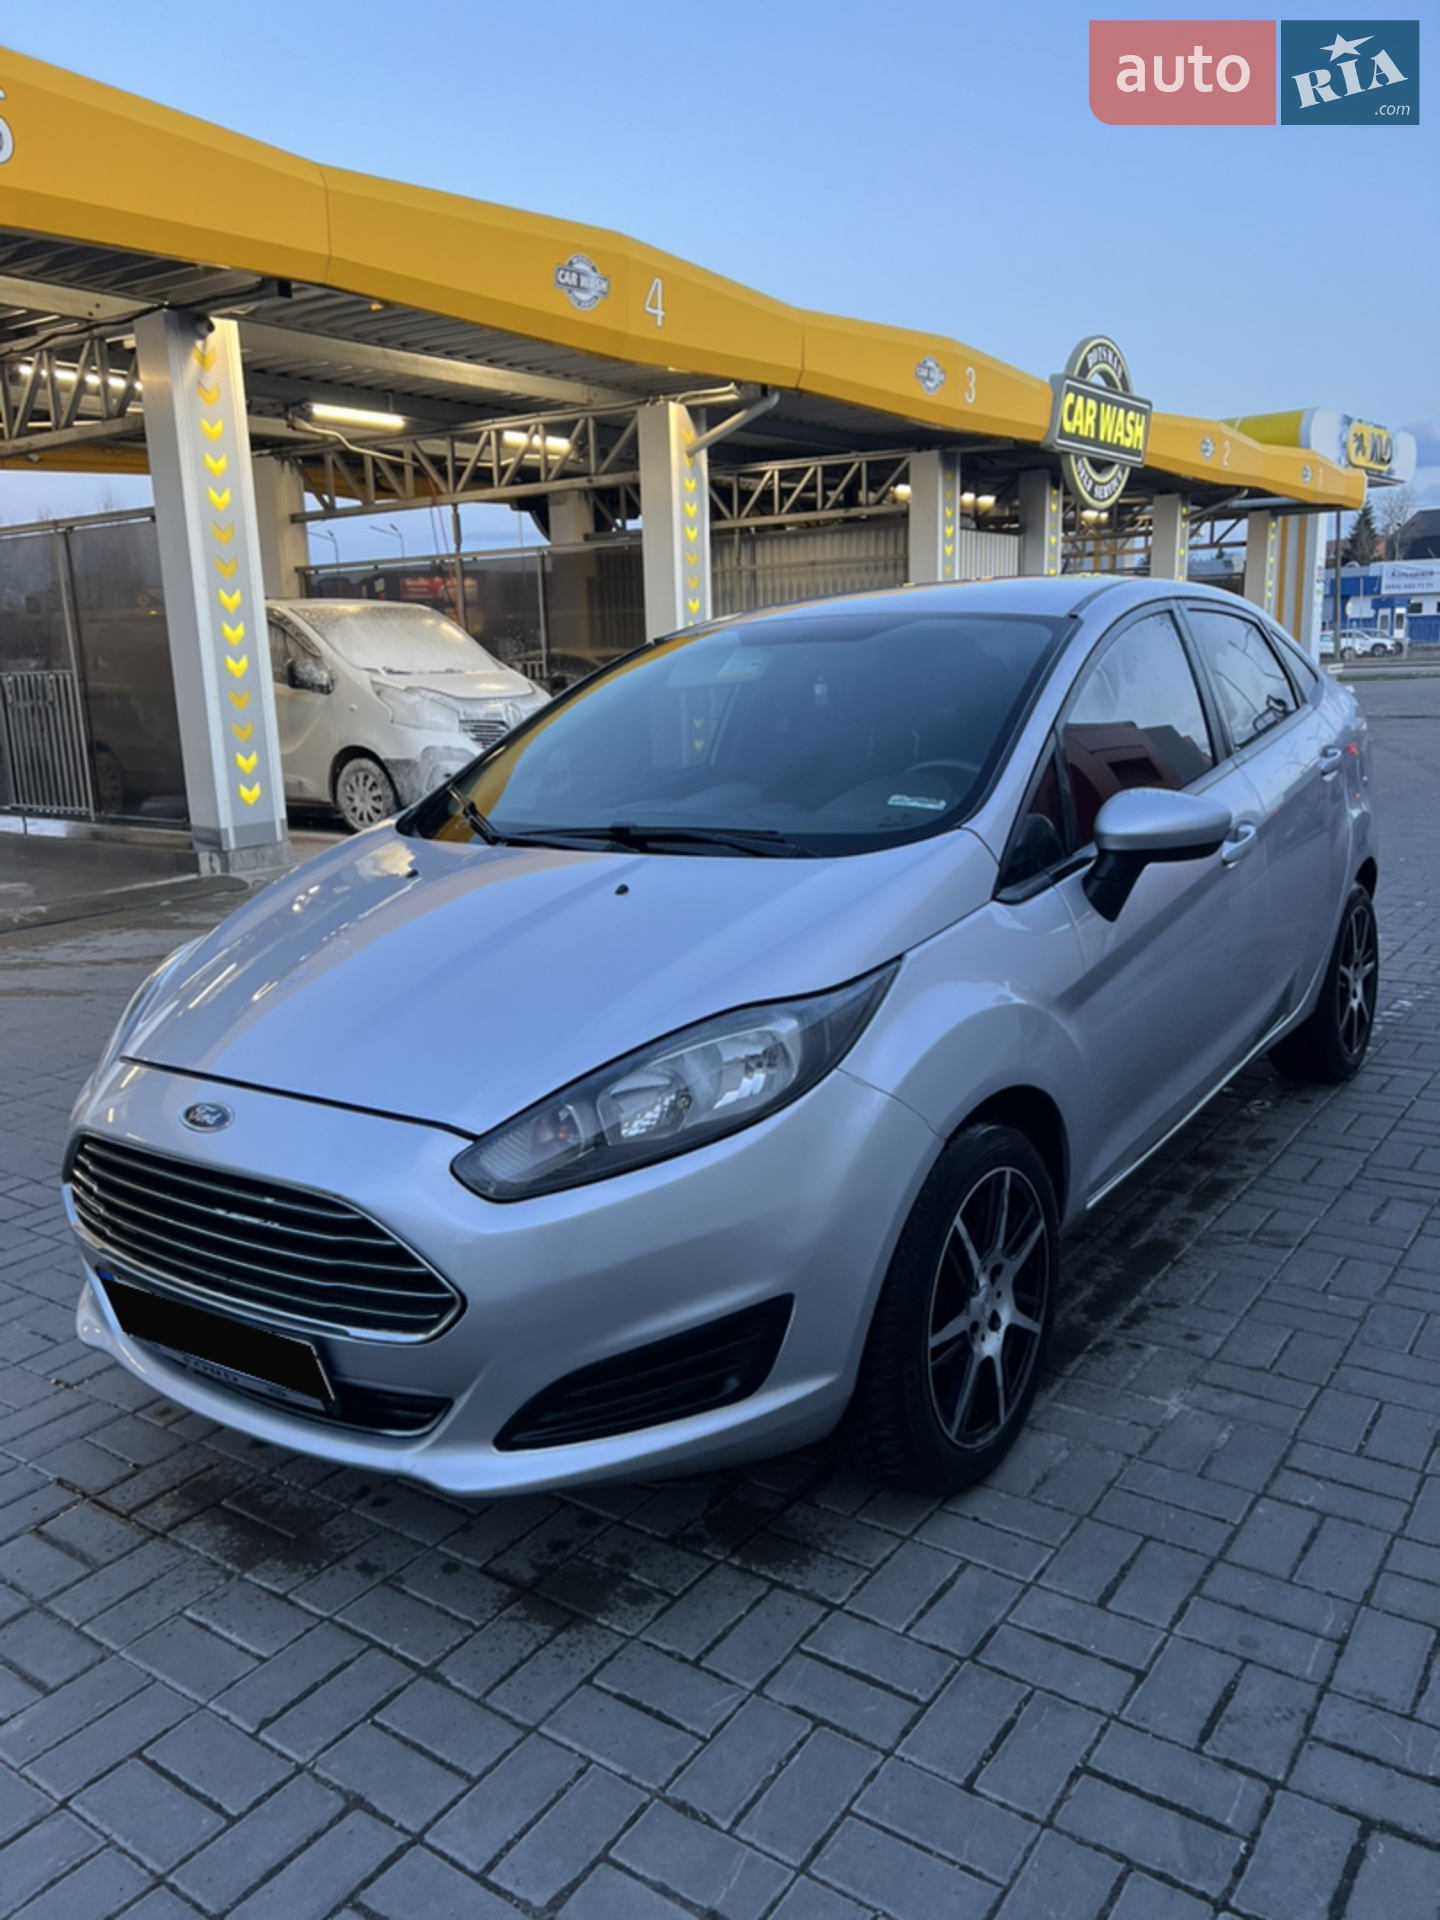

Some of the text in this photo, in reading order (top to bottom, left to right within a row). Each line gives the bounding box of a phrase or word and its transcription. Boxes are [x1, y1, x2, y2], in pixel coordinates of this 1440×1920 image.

[557, 268, 580, 288] CAR
[644, 276, 666, 329] 4
[963, 365, 976, 404] 3
[1062, 391, 1147, 452] CAR WASH
[1222, 439, 1231, 468] 2
[188, 1104, 222, 1126] Ford
